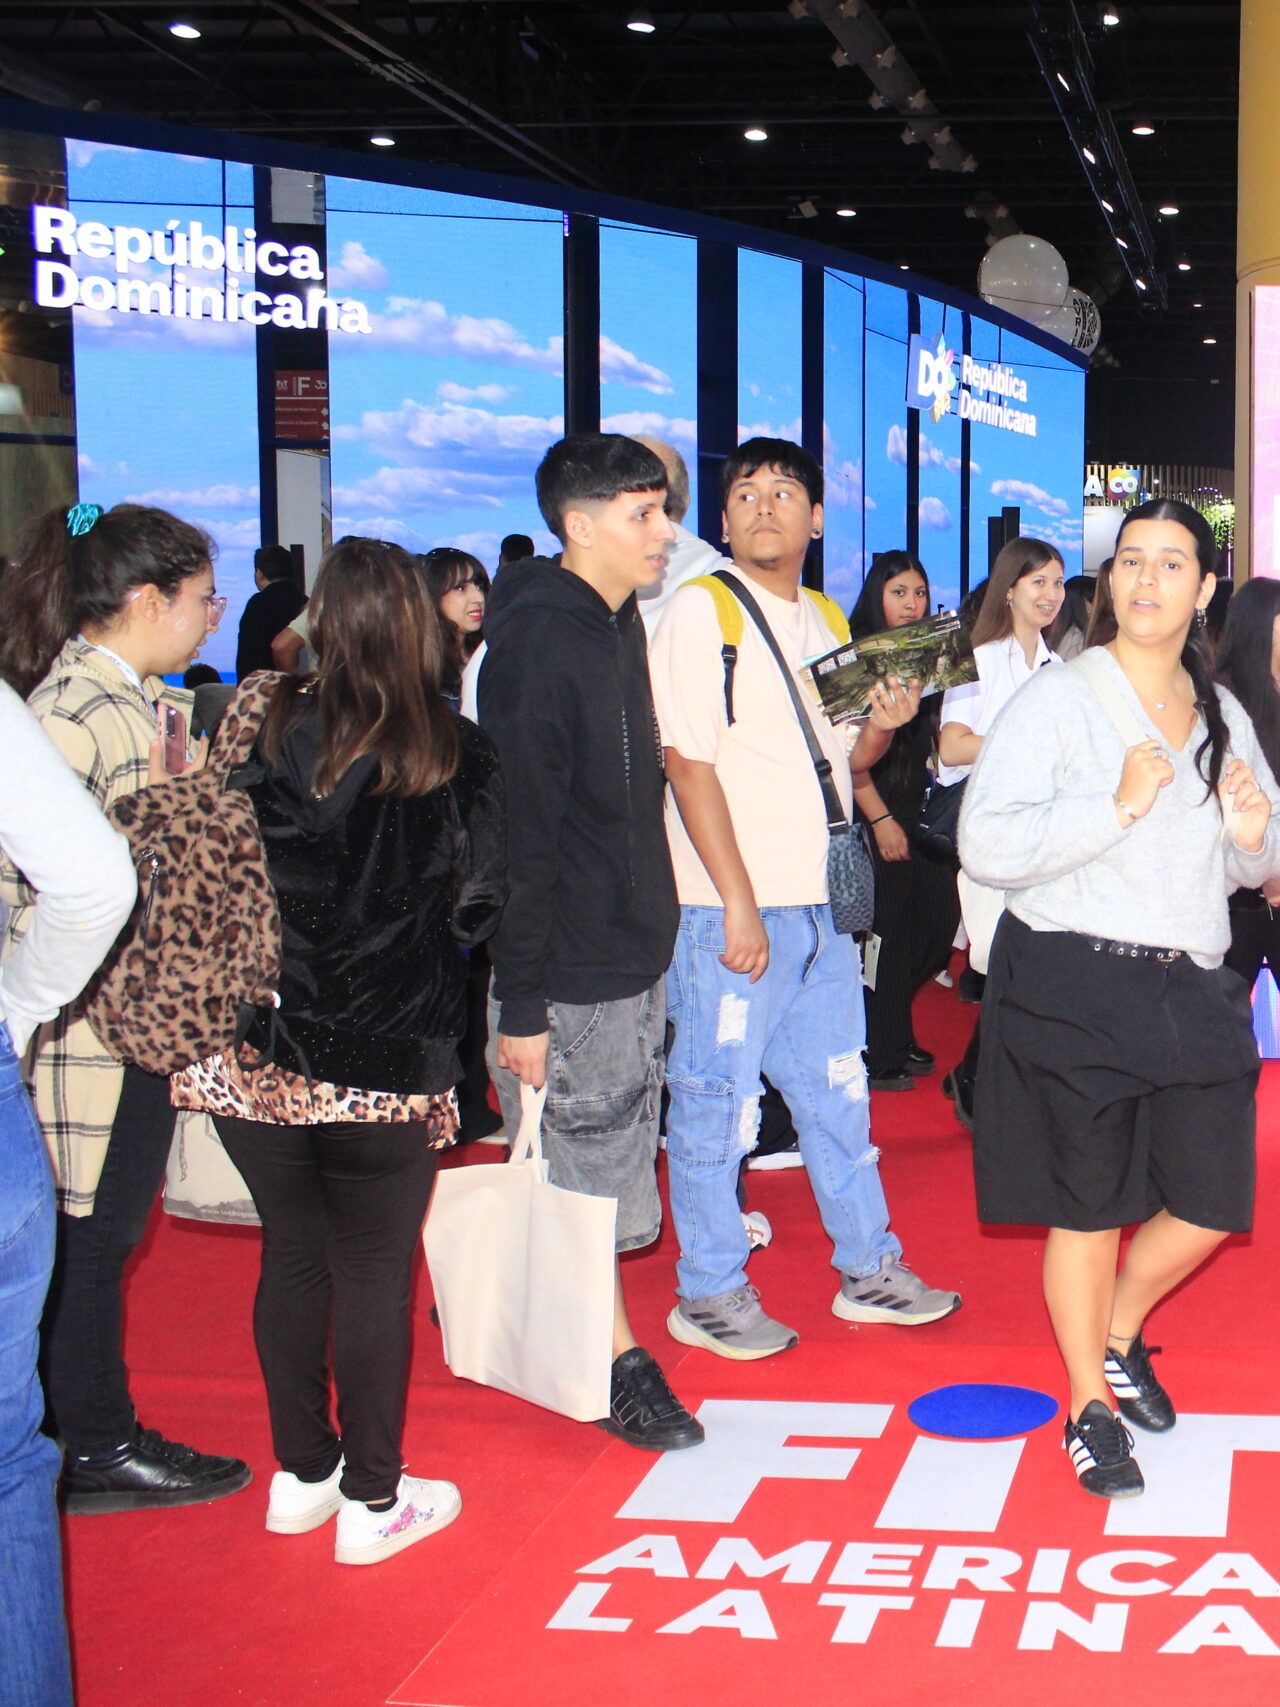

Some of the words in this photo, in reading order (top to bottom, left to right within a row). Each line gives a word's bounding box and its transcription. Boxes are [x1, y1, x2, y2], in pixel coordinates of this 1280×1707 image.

[33, 203, 324, 281] República
[37, 260, 373, 334] Dominicana
[961, 354, 1027, 402] República
[959, 389, 1037, 437] Dominicana
